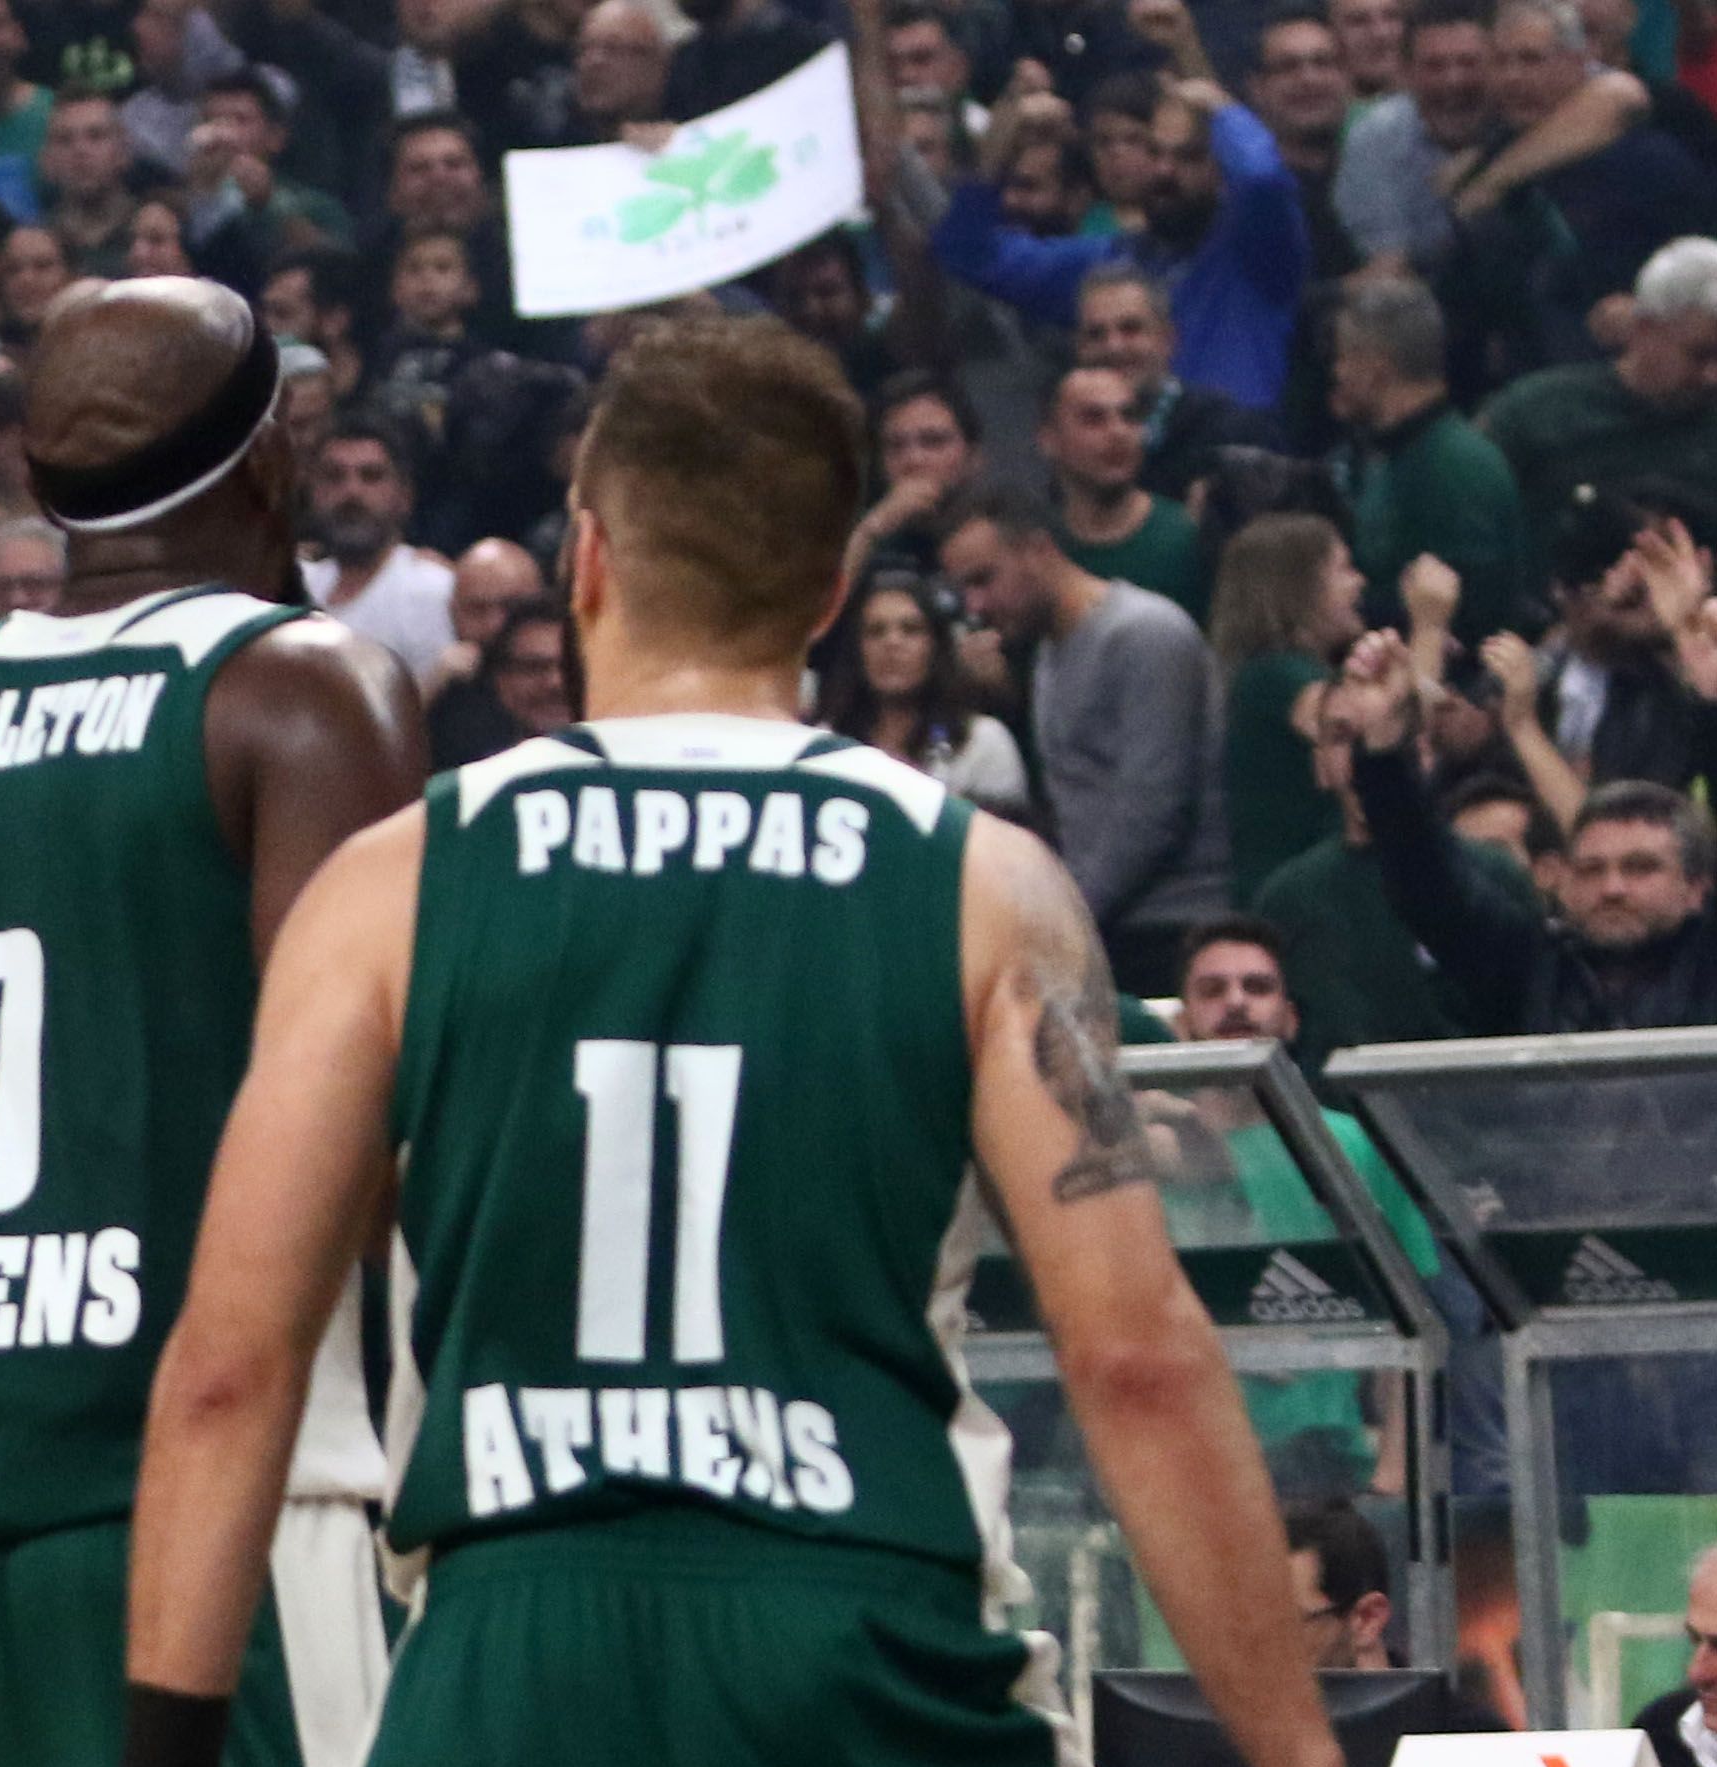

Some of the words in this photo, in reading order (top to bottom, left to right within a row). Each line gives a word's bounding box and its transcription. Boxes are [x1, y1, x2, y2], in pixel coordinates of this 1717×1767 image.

[513, 785, 870, 886] PAPPAS
[574, 1038, 743, 1364] 11
[463, 1382, 855, 1518] ATHENS
